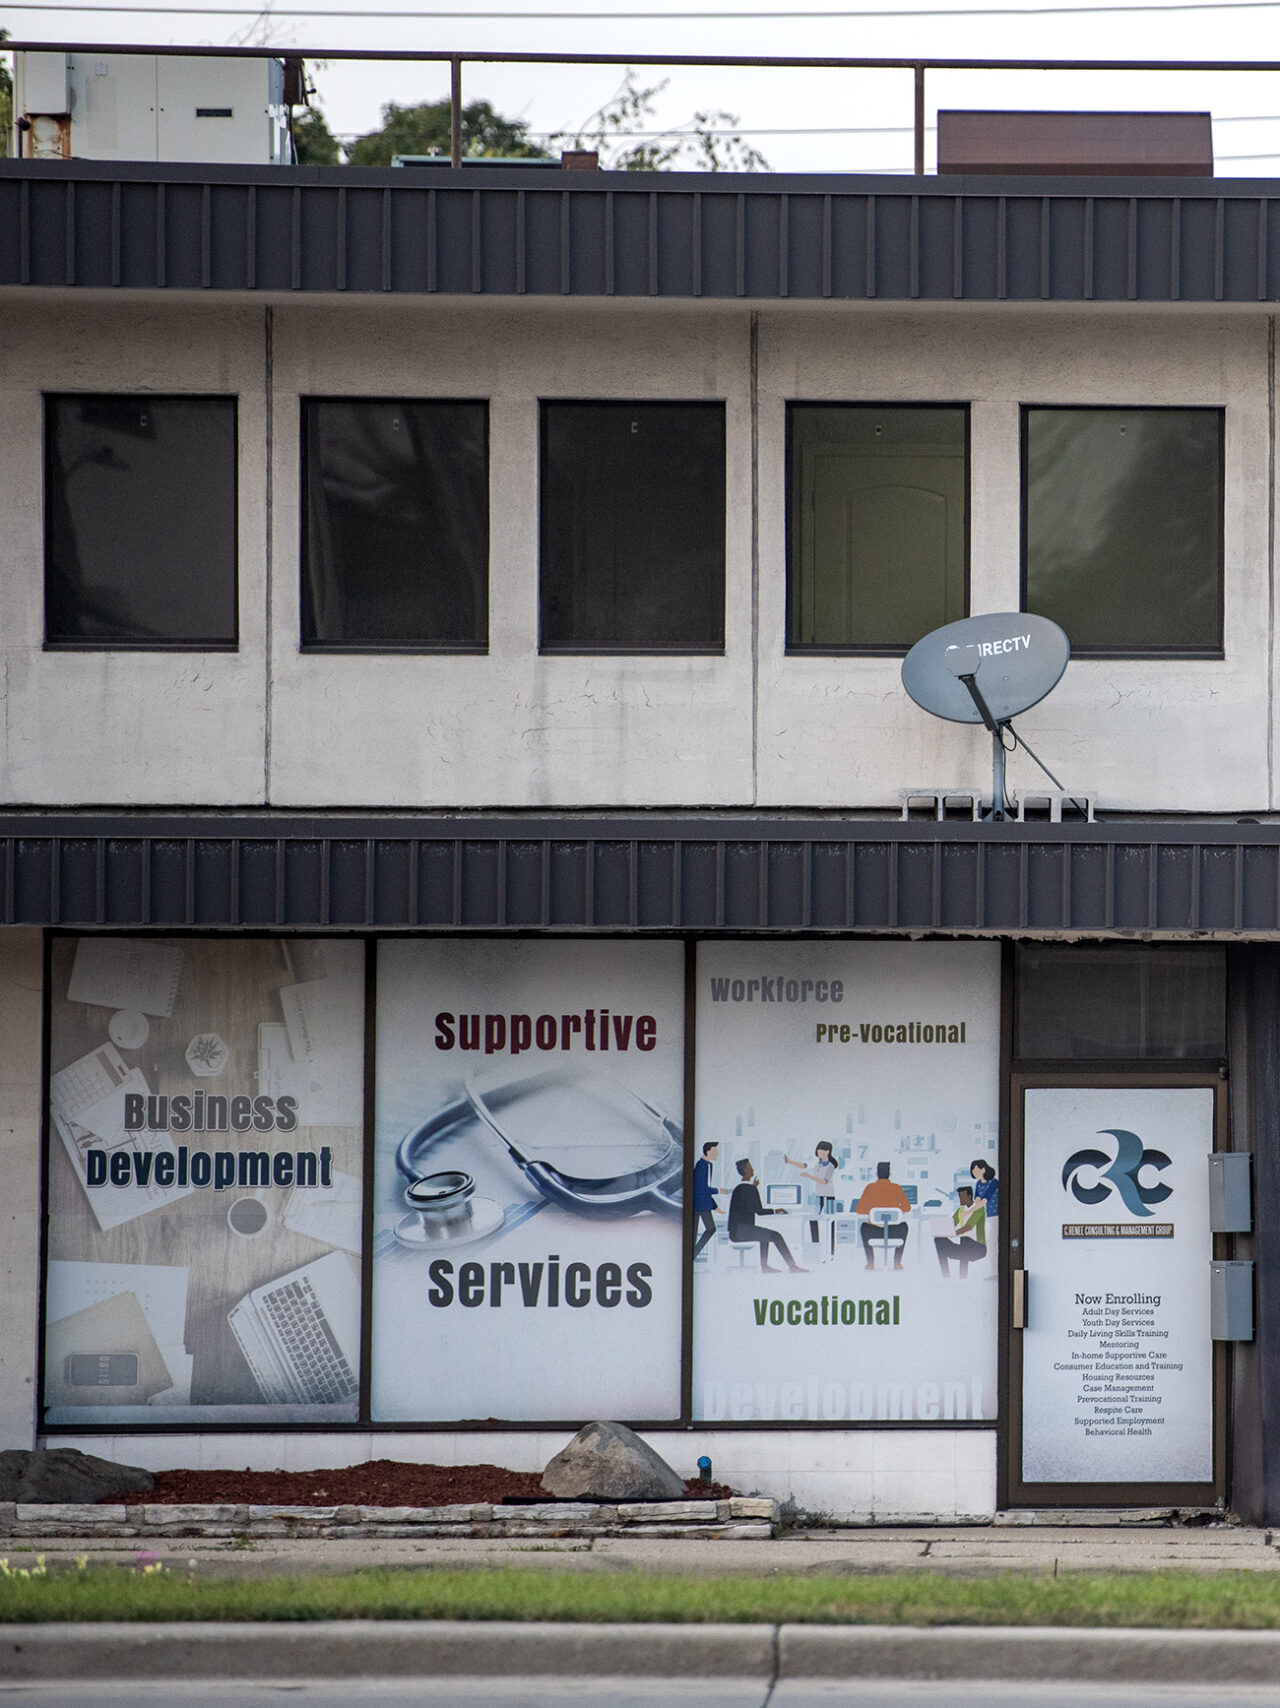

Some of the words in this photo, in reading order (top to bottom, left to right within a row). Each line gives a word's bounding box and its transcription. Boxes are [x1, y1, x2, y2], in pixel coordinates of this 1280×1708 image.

[967, 634, 1031, 657] IRECTV
[710, 976, 845, 1003] Workforce
[434, 1010, 657, 1055] Supportive
[816, 1022, 967, 1044] Pre-Vocational
[124, 1090, 298, 1132] Business
[858, 1145, 869, 1159] 7
[86, 1145, 333, 1191] Development
[1061, 1129, 1174, 1217] CRC
[1085, 1225, 1115, 1236] CONSULTING
[1120, 1225, 1155, 1235] MANAGEMENT
[1155, 1225, 1173, 1235] GROUP
[428, 1254, 653, 1309] Services
[1075, 1294, 1102, 1304] Now
[1106, 1293, 1161, 1307] Enrolling
[753, 1295, 900, 1326] Vocational
[1105, 1308, 1120, 1317] Day
[1105, 1319, 1120, 1328] Day
[1122, 1318, 1155, 1326] Services
[1068, 1330, 1088, 1339] Daily
[1090, 1330, 1113, 1339] Living
[1136, 1330, 1169, 1339] Training
[1100, 1341, 1140, 1350] Mentoring
[1105, 1352, 1147, 1361] Supportive
[1148, 1351, 1167, 1359] Care
[1096, 1362, 1133, 1370] Education
[1135, 1362, 1150, 1370] and
[1151, 1362, 1183, 1371] Training
[1082, 1374, 1114, 1382] Housing
[1116, 1373, 1155, 1381] Resources
[1083, 1384, 1102, 1392] Case
[1104, 1384, 1154, 1393] Management
[703, 1375, 985, 1421] Development
[1078, 1395, 1128, 1403] Prevocational
[1130, 1395, 1162, 1404] Training
[1094, 1406, 1123, 1415] Respite
[1124, 1406, 1143, 1414] Care
[1074, 1417, 1115, 1427] Supported
[1117, 1417, 1165, 1426] Employment
[1085, 1428, 1126, 1436] Behavioral
